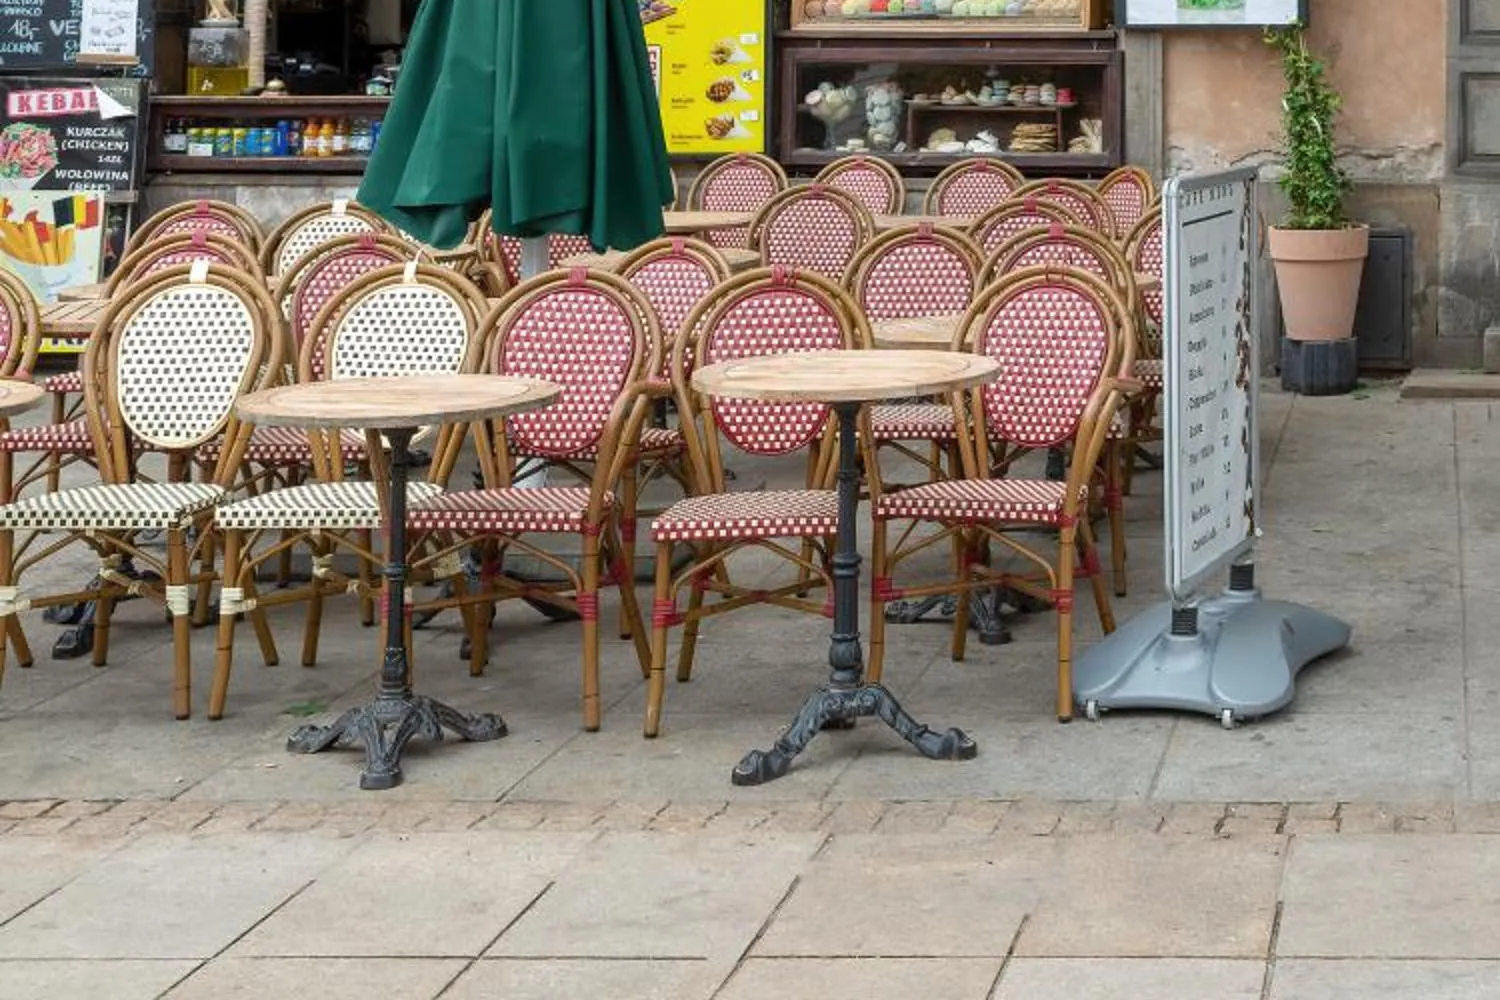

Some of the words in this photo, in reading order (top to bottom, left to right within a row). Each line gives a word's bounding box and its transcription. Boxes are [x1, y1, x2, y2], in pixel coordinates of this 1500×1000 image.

[49, 19, 80, 36] VE
[66, 127, 126, 137] KURCZAK
[61, 139, 129, 152] (CHICKEN)
